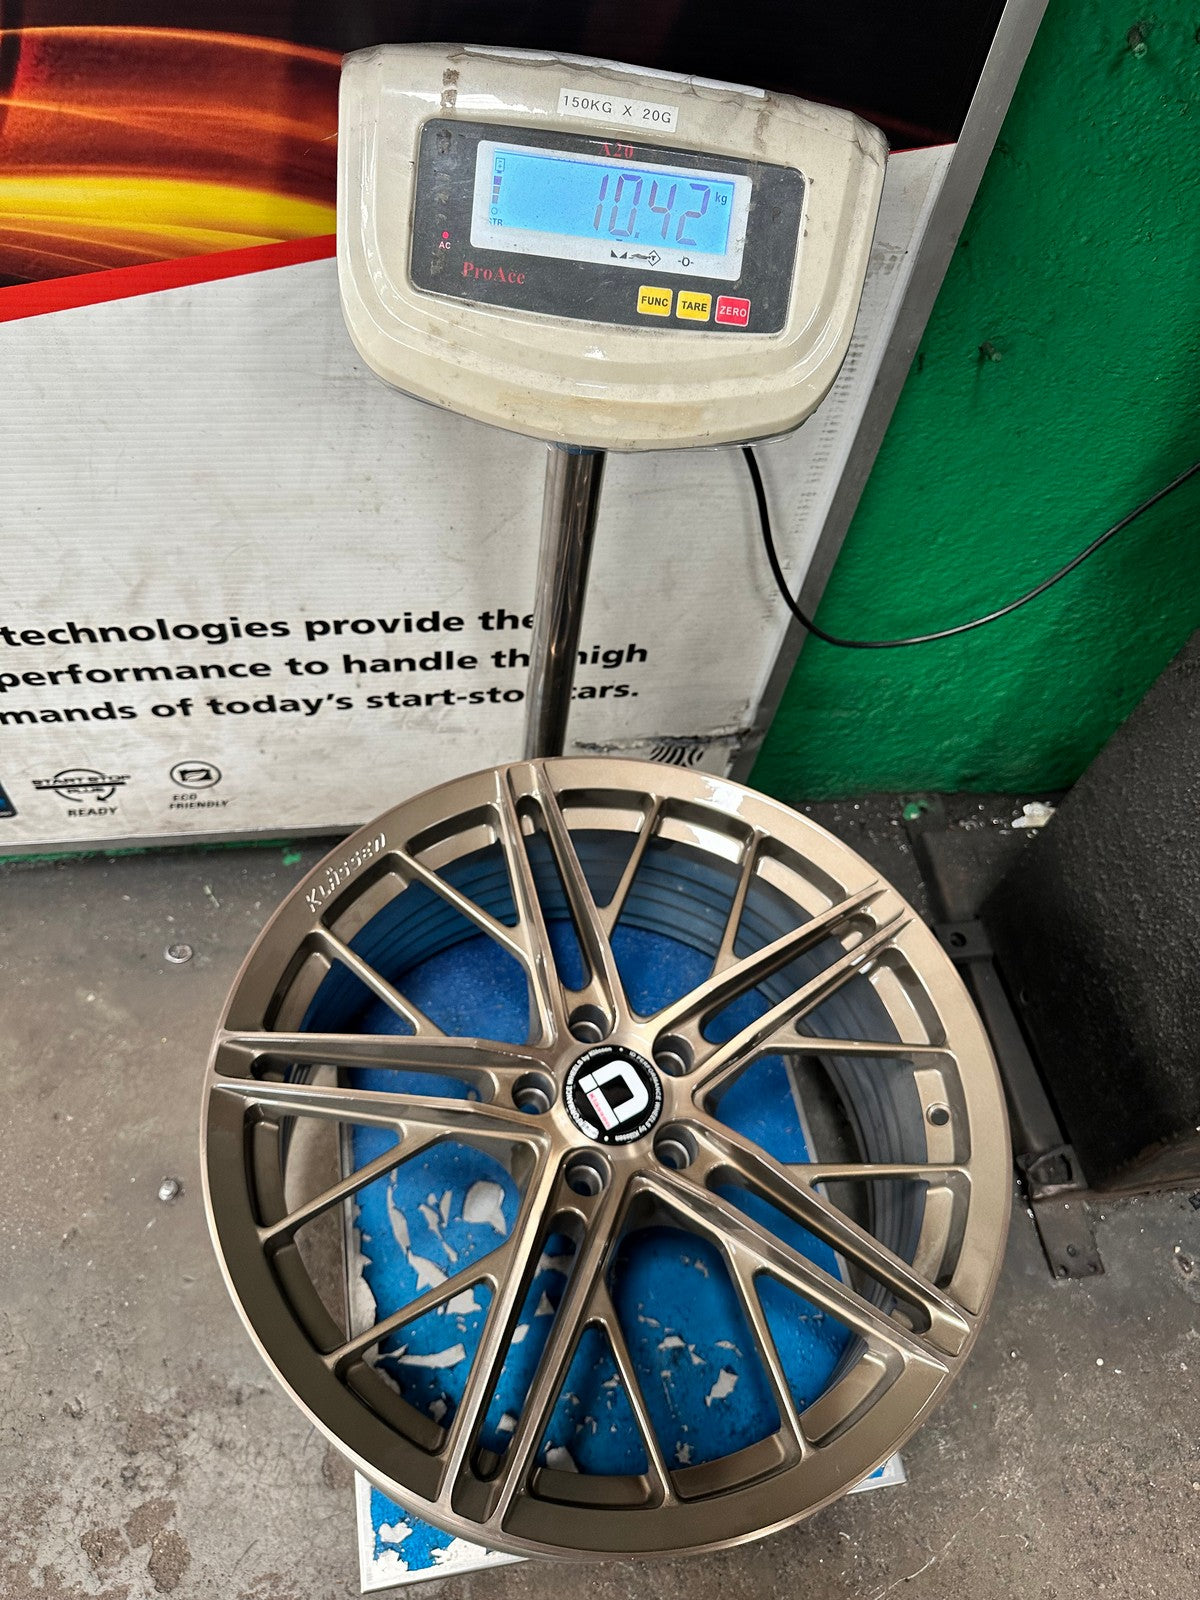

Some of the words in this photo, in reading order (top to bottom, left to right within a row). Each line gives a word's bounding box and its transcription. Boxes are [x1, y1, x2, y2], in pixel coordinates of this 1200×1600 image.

[563, 95, 613, 114] 150KG
[622, 104, 633, 117] X
[642, 108, 672, 124] 20G
[599, 141, 635, 159] A20
[715, 191, 728, 205] kg
[438, 241, 451, 249] AC
[462, 261, 526, 285] ProAce
[641, 295, 669, 307] FUNC
[681, 300, 708, 312] TARE
[719, 305, 747, 318] ZERO
[0, 616, 290, 646] technologies
[305, 610, 465, 641] provide
[0, 662, 272, 692] performance
[285, 657, 329, 676] to
[342, 650, 479, 674] handle
[490, 648, 530, 668] th
[0, 702, 138, 725] mands
[151, 698, 193, 718] of
[366, 686, 524, 709] start-sto
[571, 682, 639, 700] ars.
[173, 793, 198, 801] ECO
[168, 800, 229, 810] FRIENDLY
[68, 807, 118, 817] READY
